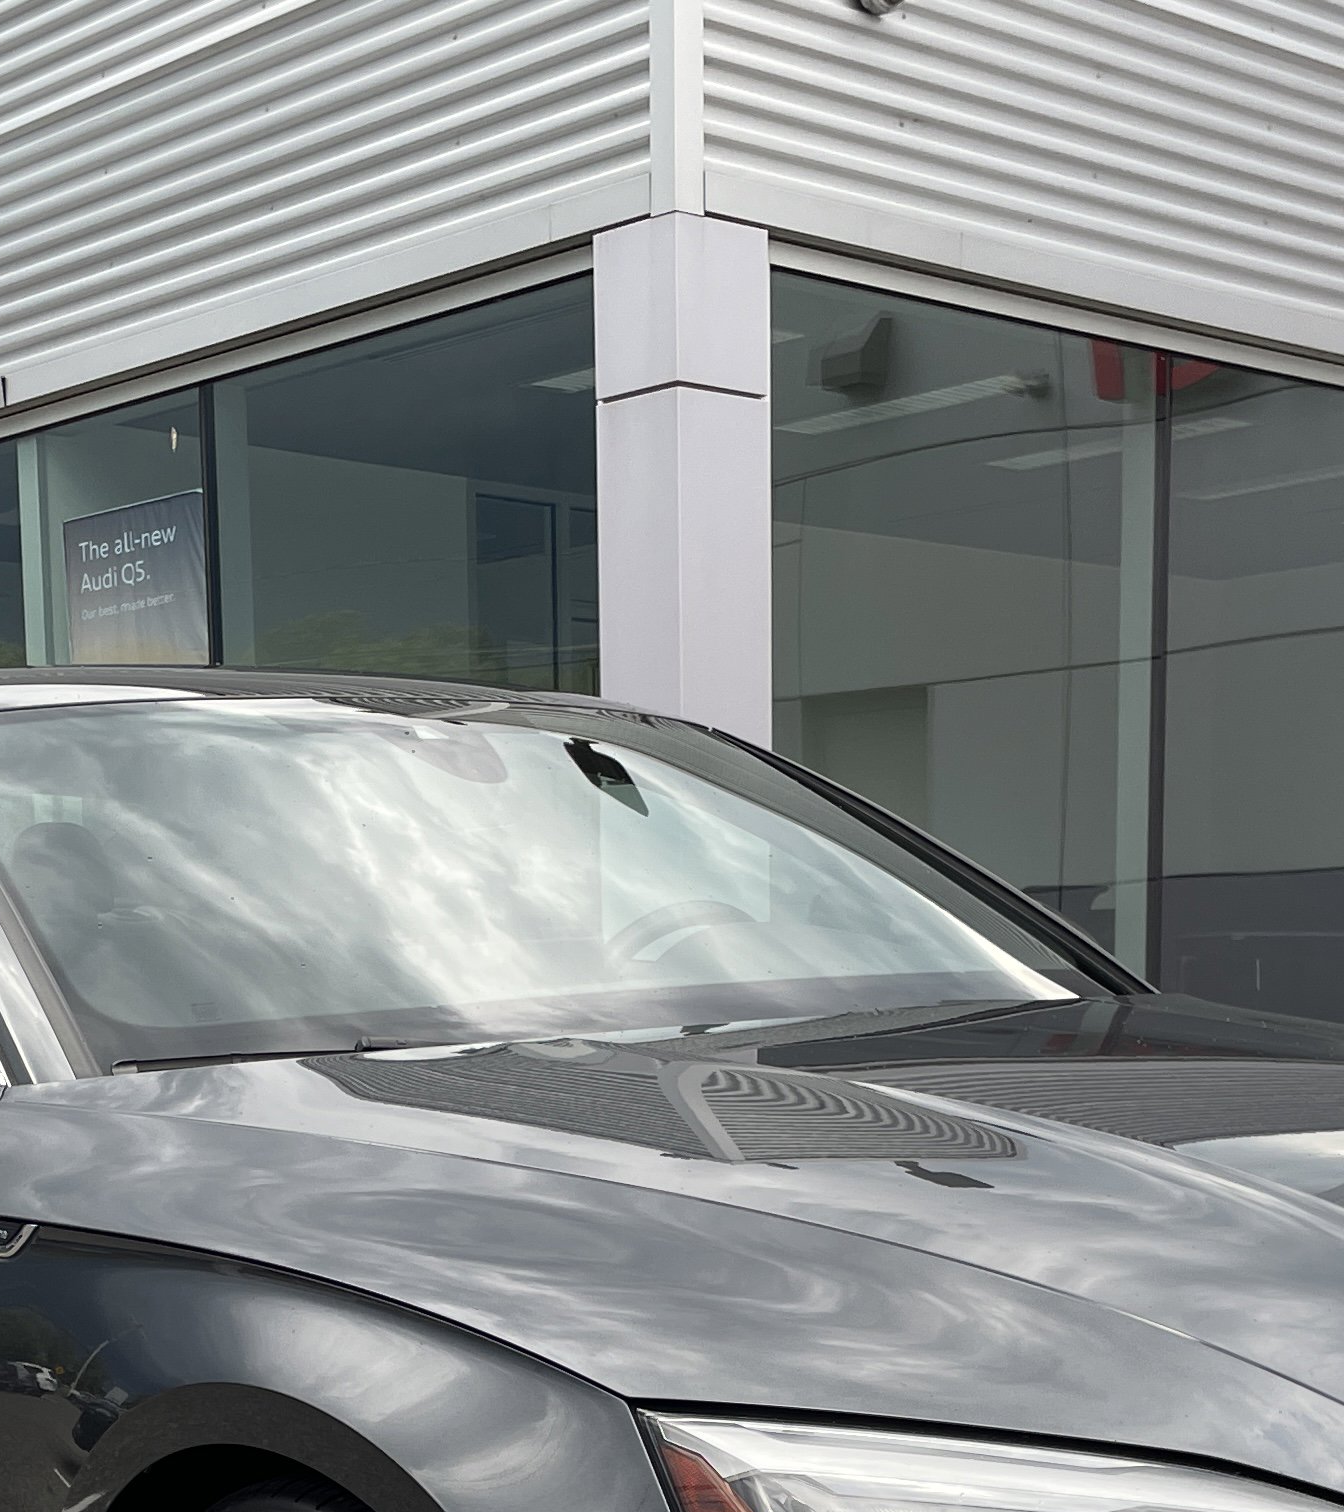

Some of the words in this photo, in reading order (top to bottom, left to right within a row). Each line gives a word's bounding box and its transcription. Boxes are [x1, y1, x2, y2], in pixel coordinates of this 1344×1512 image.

[78, 541, 109, 562] The
[114, 526, 177, 555] all-new
[80, 566, 119, 594] Audi
[121, 560, 151, 586] Q5.
